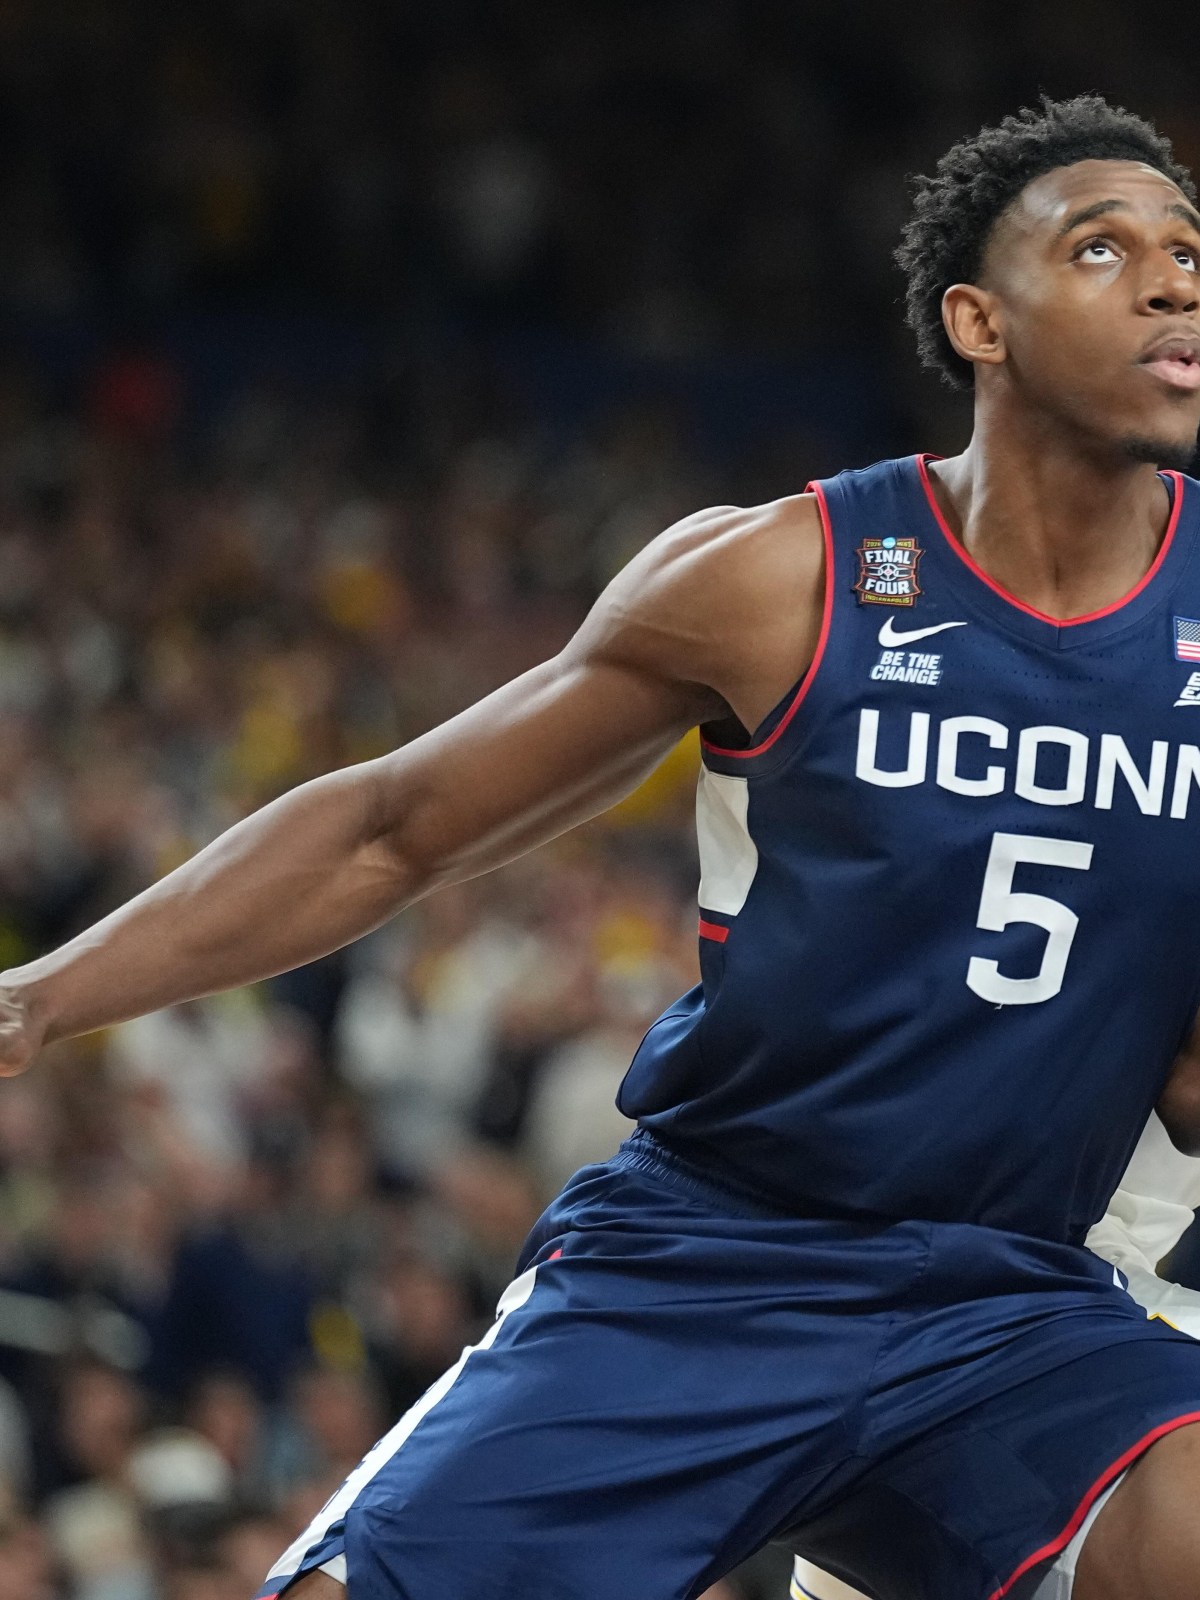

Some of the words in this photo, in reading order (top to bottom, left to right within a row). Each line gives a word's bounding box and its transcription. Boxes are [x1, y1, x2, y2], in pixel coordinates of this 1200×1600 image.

[865, 550, 911, 565] FINAL
[865, 578, 910, 595] FOUR
[880, 651, 905, 666] BE
[908, 652, 941, 670] THE
[871, 664, 941, 686] CHANGE
[966, 831, 1095, 1006] 5
